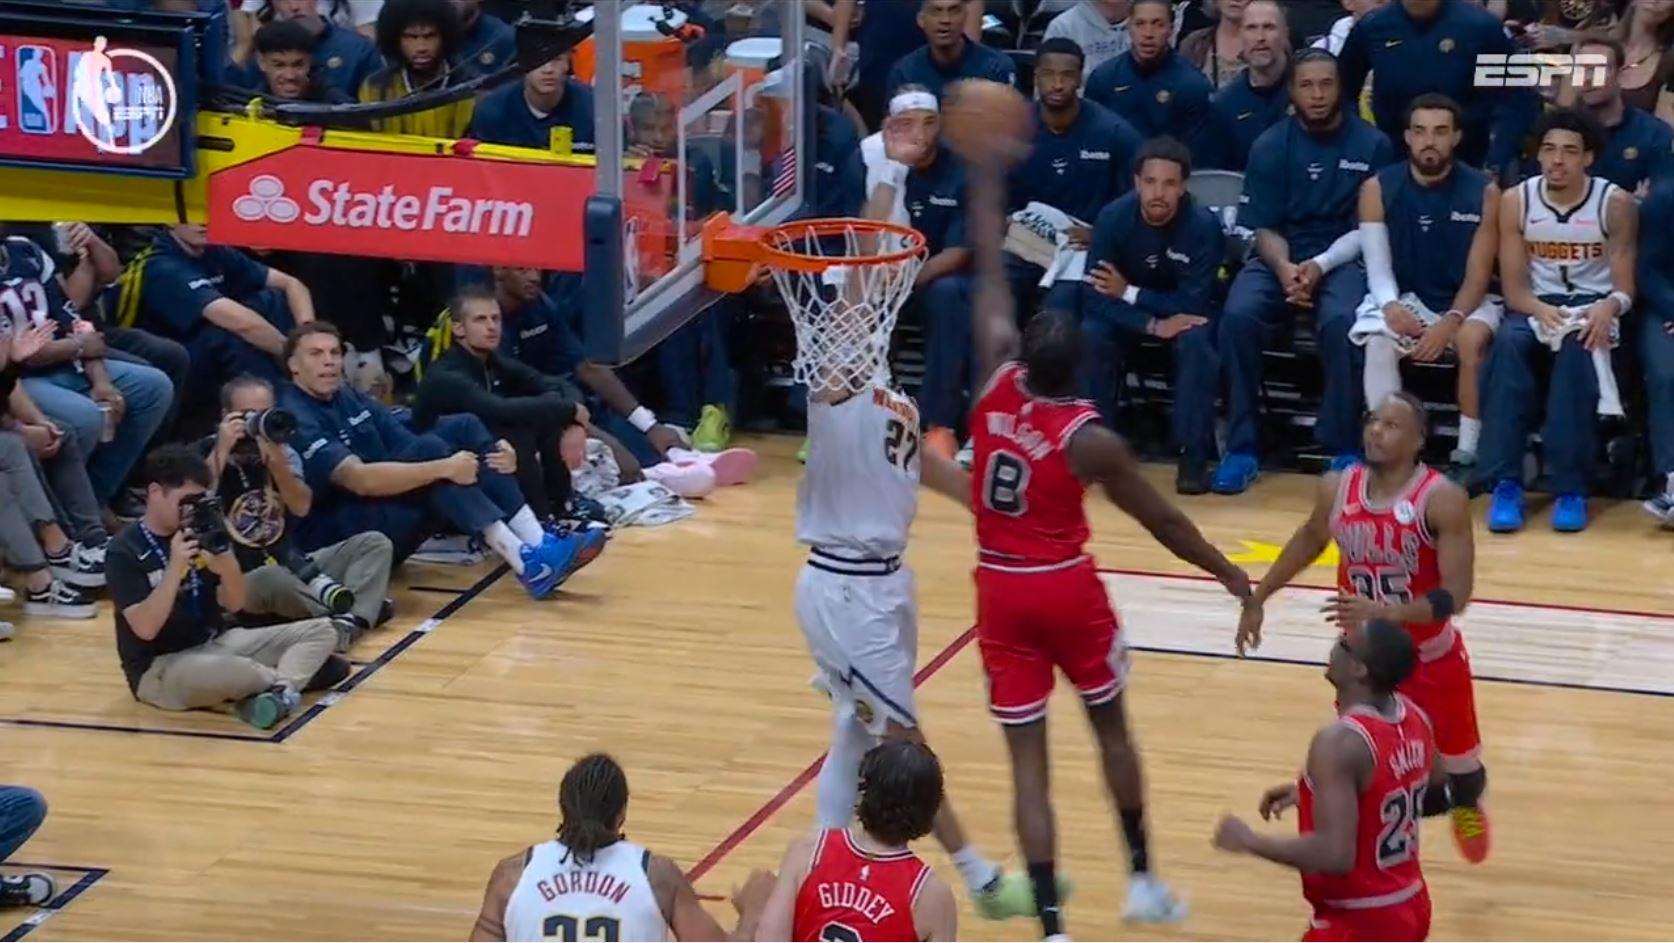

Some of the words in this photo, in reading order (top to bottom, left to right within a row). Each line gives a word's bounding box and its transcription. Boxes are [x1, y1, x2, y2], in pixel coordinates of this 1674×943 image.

[884, 418, 918, 472] 27
[536, 870, 631, 904] GORDON
[818, 881, 895, 925] GIDDEY
